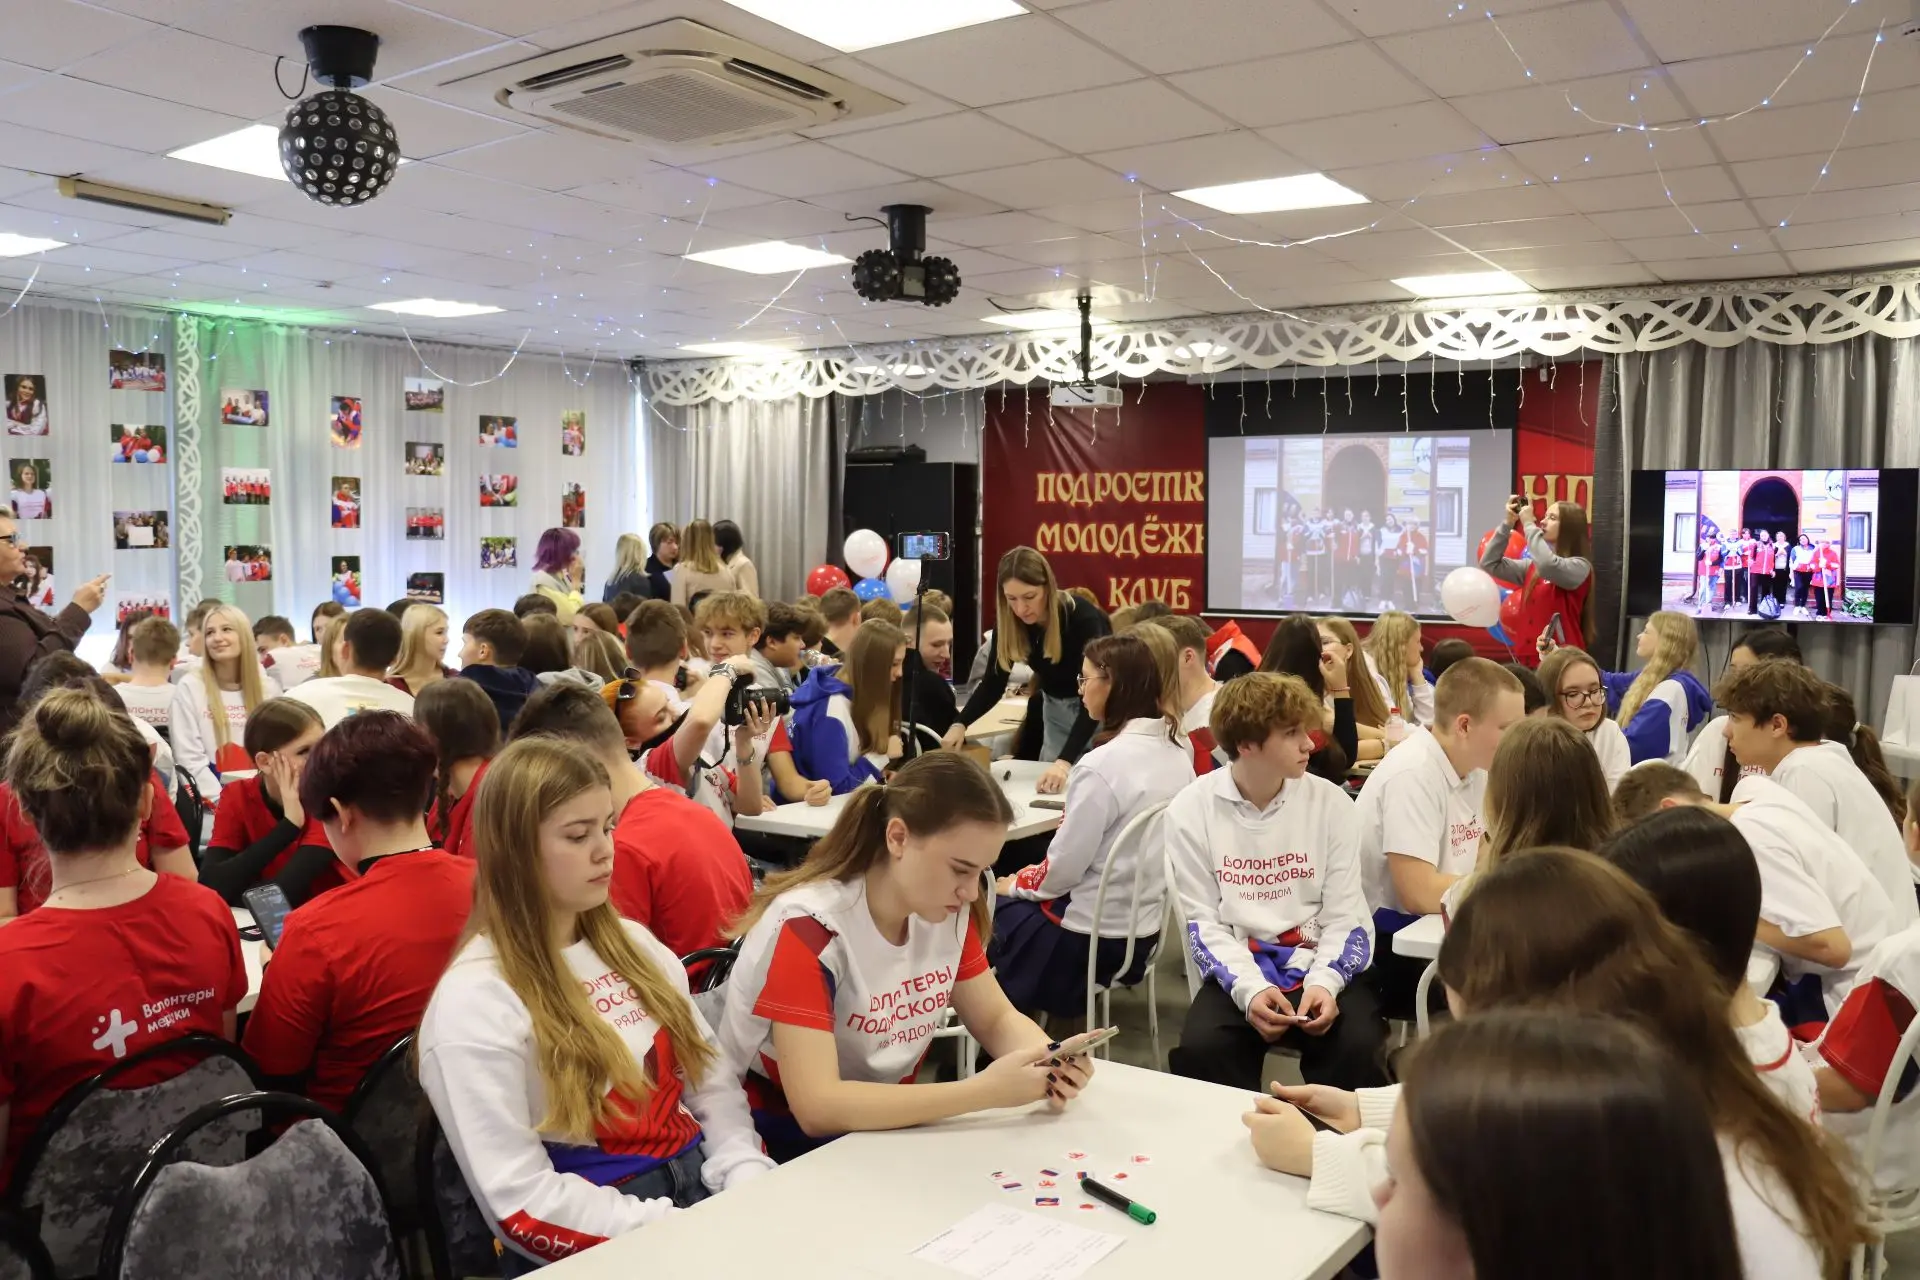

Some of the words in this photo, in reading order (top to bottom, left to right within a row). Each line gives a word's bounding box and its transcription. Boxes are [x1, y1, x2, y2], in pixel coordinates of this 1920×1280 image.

[1109, 577, 1192, 610] КЛУБ
[1223, 852, 1308, 871] ВОЛОНТЕРЫ
[1238, 890, 1255, 901] МЫ
[1257, 886, 1293, 901] РЯДОМ
